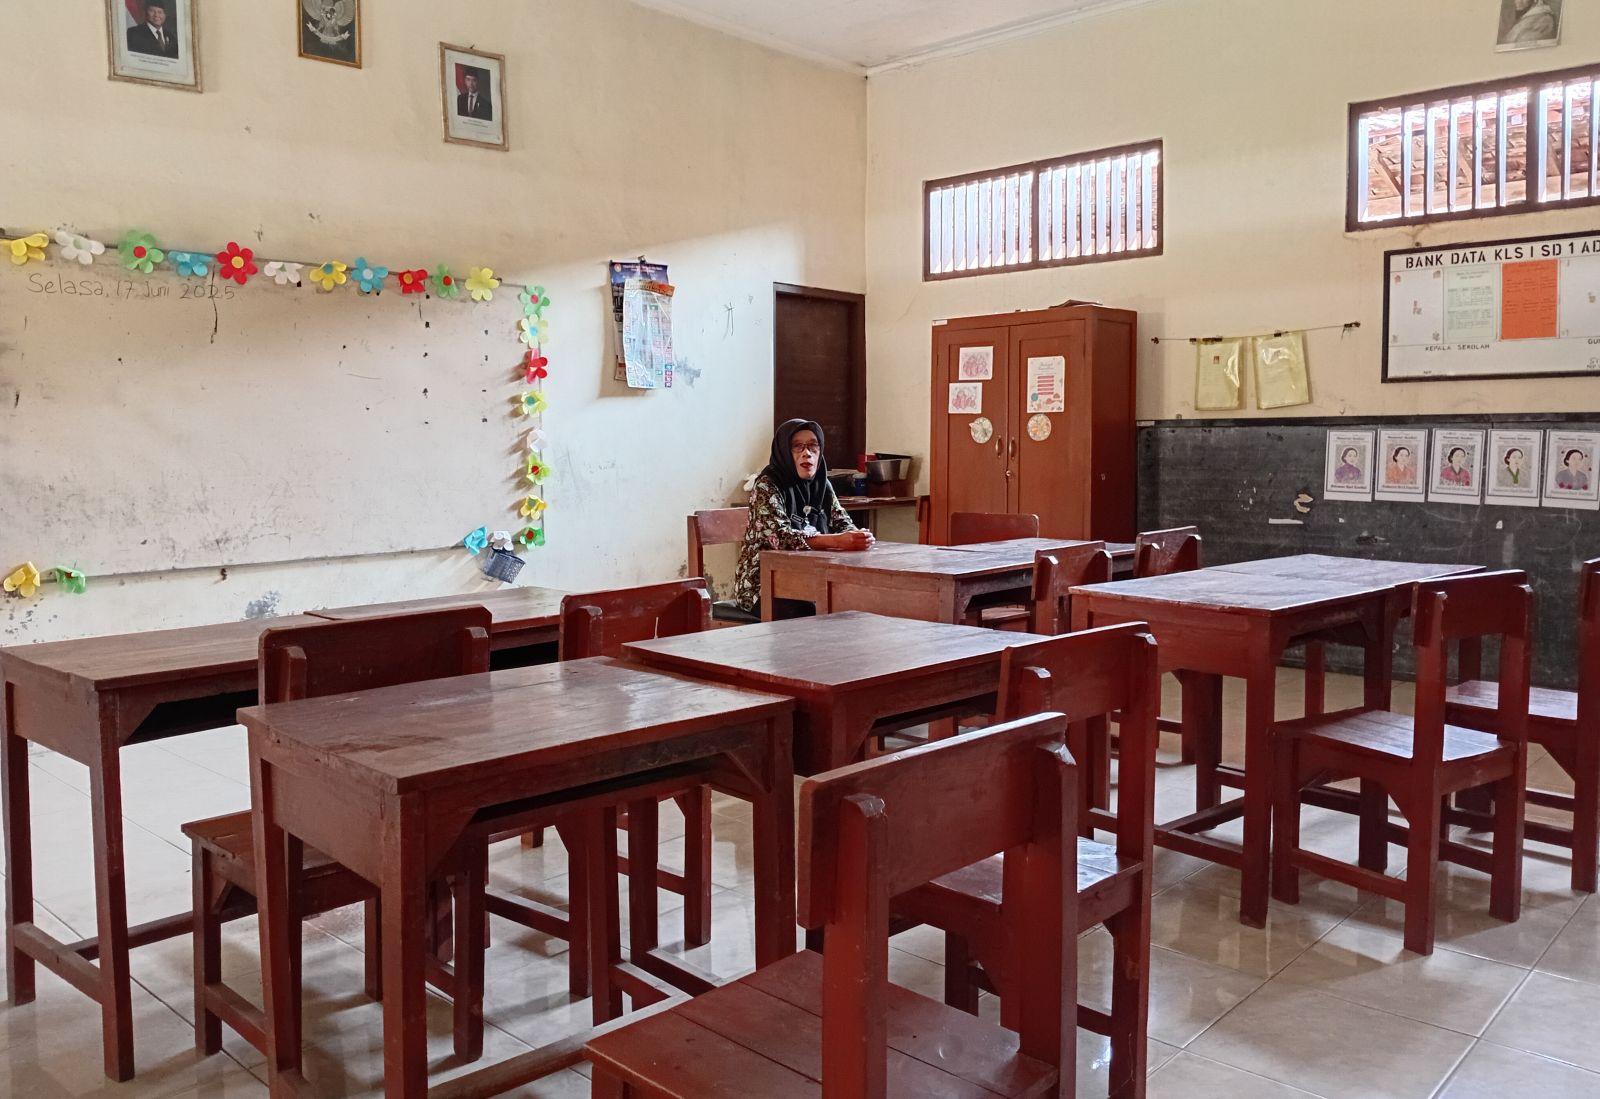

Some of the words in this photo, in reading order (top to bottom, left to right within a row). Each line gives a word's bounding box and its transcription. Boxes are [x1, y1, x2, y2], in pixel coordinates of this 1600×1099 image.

[1405, 253, 1443, 269] BANK
[1451, 250, 1486, 265] DATA
[1494, 246, 1524, 260] KLS
[1541, 243, 1562, 257] SD
[1568, 241, 1574, 254] 1
[26, 272, 110, 297] Selasa,
[116, 279, 134, 299] 17
[143, 281, 170, 298] Juni
[179, 283, 236, 299] 2025
